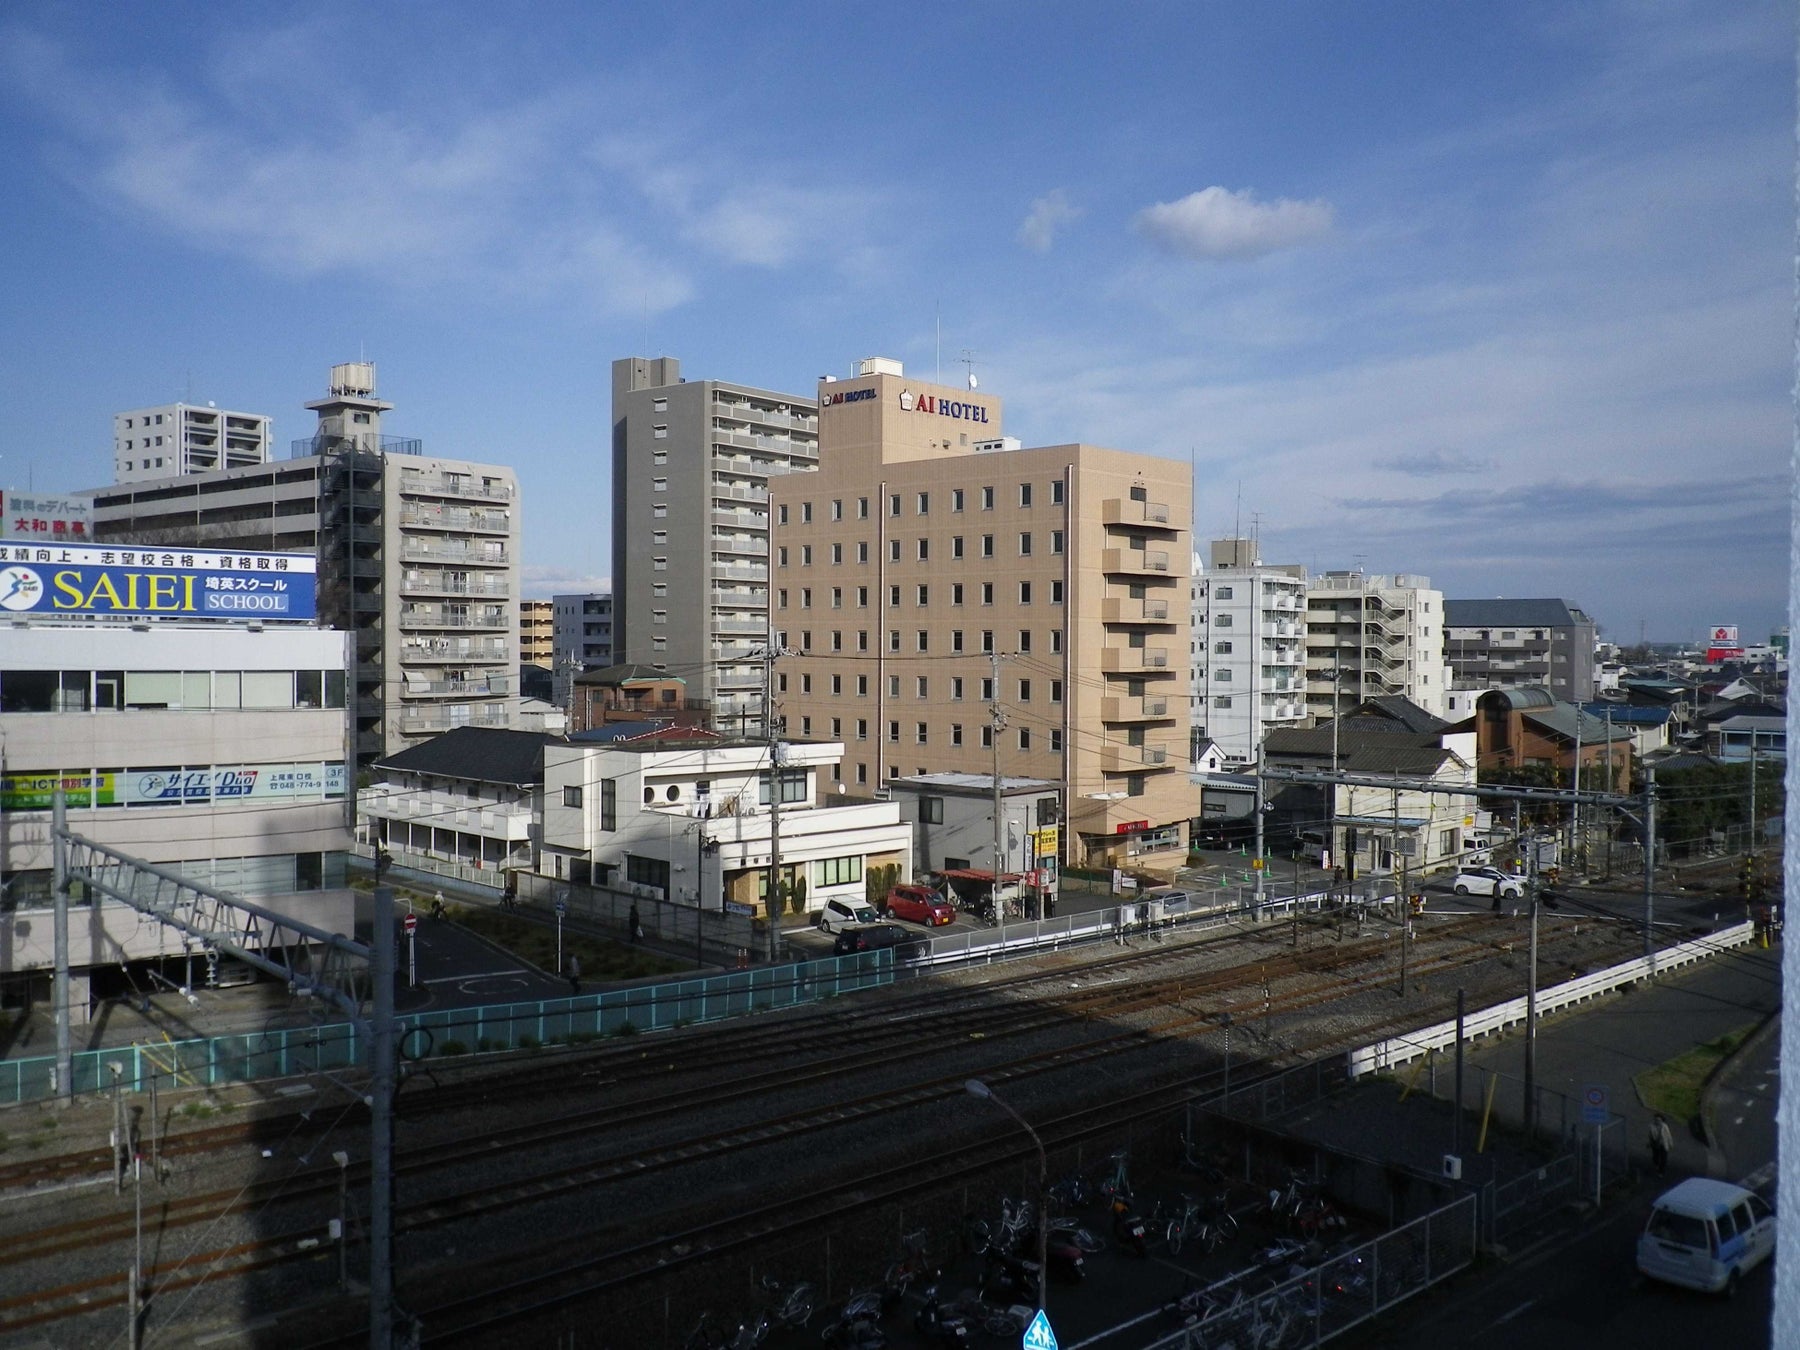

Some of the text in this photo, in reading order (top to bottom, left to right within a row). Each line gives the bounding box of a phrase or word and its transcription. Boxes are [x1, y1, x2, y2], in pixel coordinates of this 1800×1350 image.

[832, 388, 877, 404] AI HOTEL
[916, 394, 988, 423] AI HOTEL
[52, 571, 197, 612] SAIEI
[205, 577, 288, 592] 埼英スクール
[208, 594, 286, 610] SCHOOL
